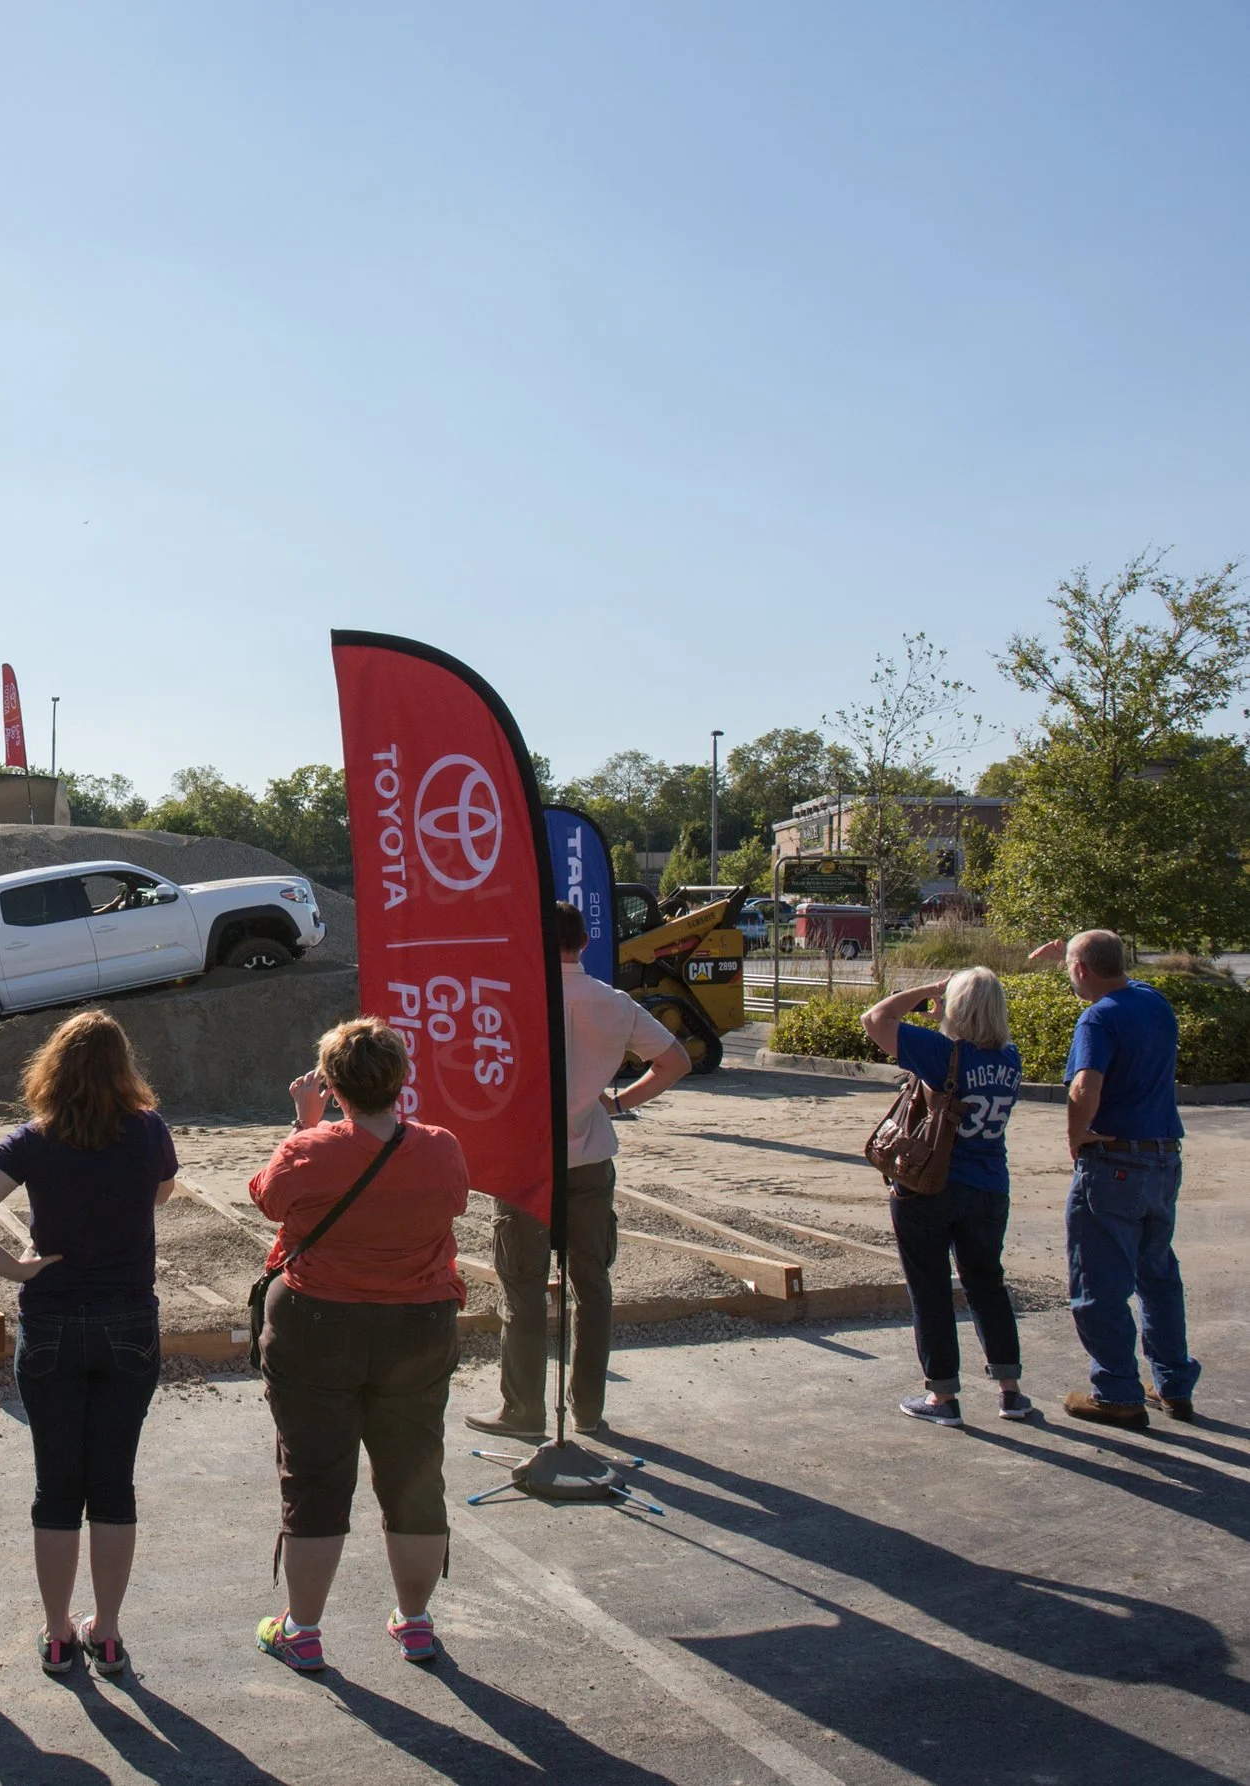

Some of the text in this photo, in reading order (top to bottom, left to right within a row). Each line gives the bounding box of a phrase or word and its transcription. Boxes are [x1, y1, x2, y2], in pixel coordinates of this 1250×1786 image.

[372, 743, 408, 911] TOYOTA
[590, 892, 601, 939] 2016
[689, 962, 714, 981] CAT
[718, 961, 738, 971] 289D
[425, 975, 466, 1043] Go
[471, 976, 514, 1086] Let's
[966, 1064, 1022, 1091] HOSMER
[958, 1095, 1014, 1139] 35
